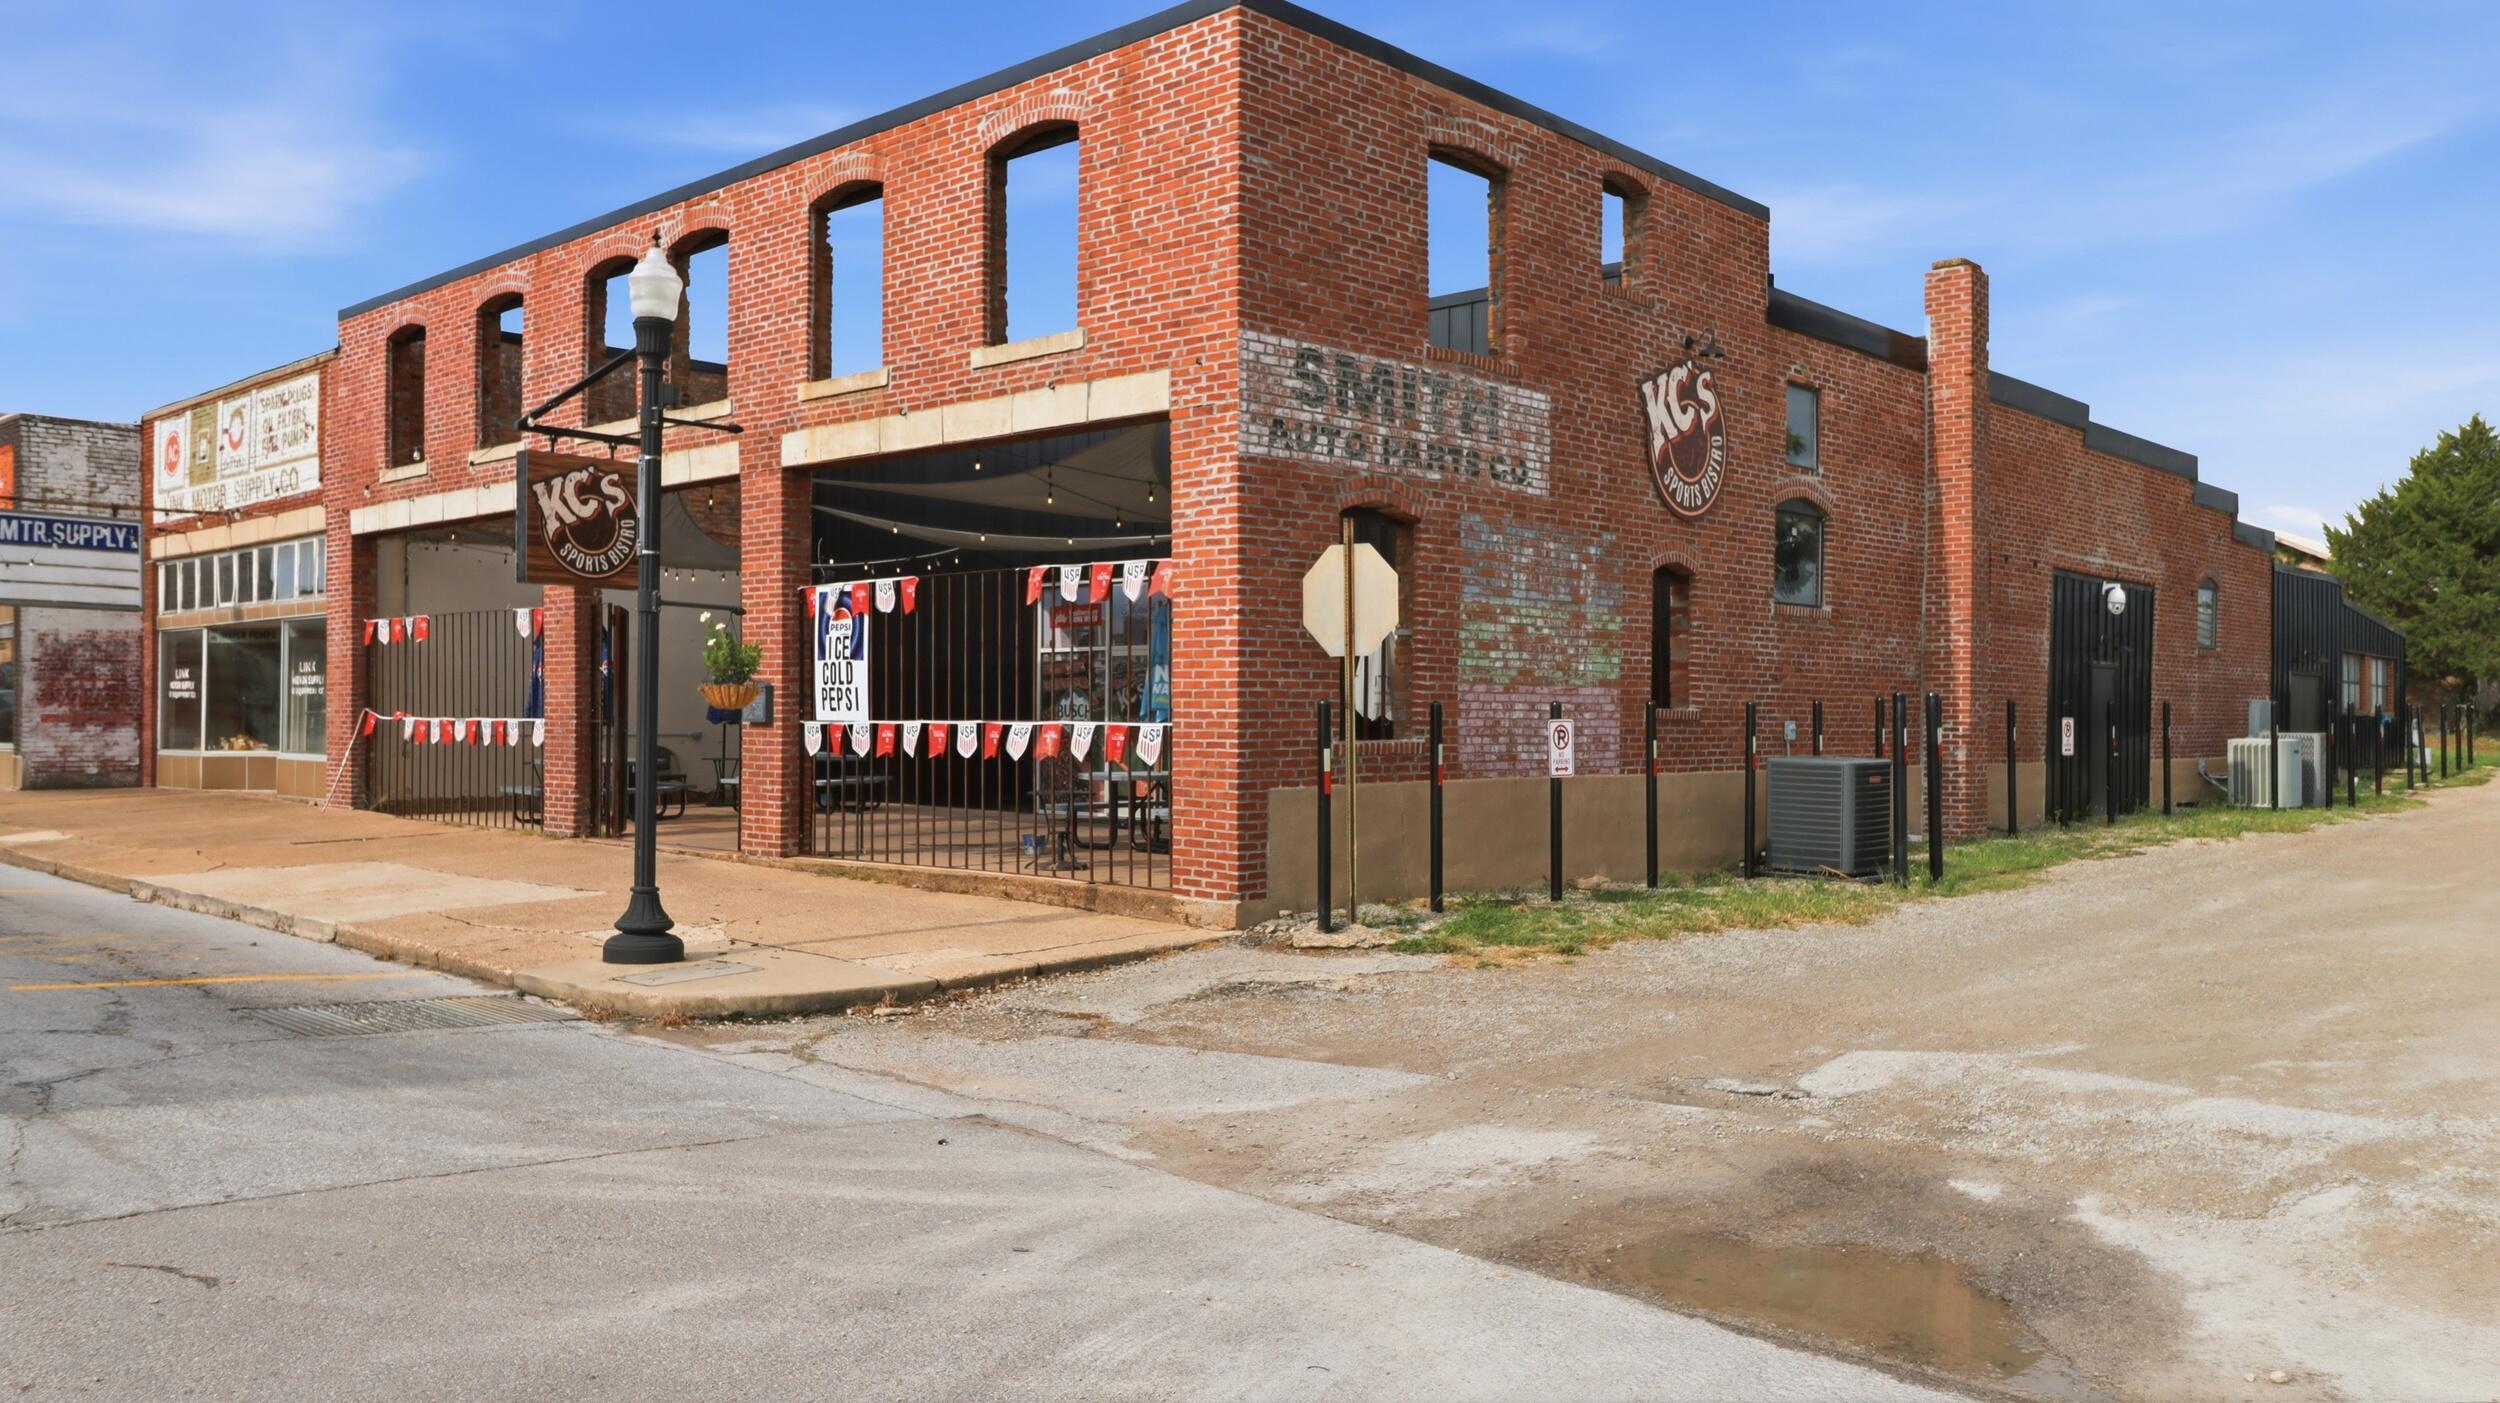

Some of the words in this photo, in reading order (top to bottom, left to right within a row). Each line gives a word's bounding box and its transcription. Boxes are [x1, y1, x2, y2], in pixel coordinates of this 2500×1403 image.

[1663, 467, 1702, 508] SPORTS
[1701, 435, 1723, 499] BISTRO
[235, 473, 275, 503] SUPPLY
[560, 543, 609, 573] SPORTS
[607, 519, 636, 566] BISTRO
[1064, 569, 1080, 580] USA
[1128, 565, 1144, 579] USA
[879, 582, 893, 595] USA
[830, 623, 851, 632] PEPSI
[828, 636, 850, 660] ICE
[822, 661, 853, 686] COLD
[821, 687, 860, 712] PEPSI
[807, 726, 820, 737] USA
[960, 726, 974, 738] USA
[1014, 727, 1030, 739] USA
[1076, 727, 1092, 740] USA
[1142, 729, 1161, 742] USA
